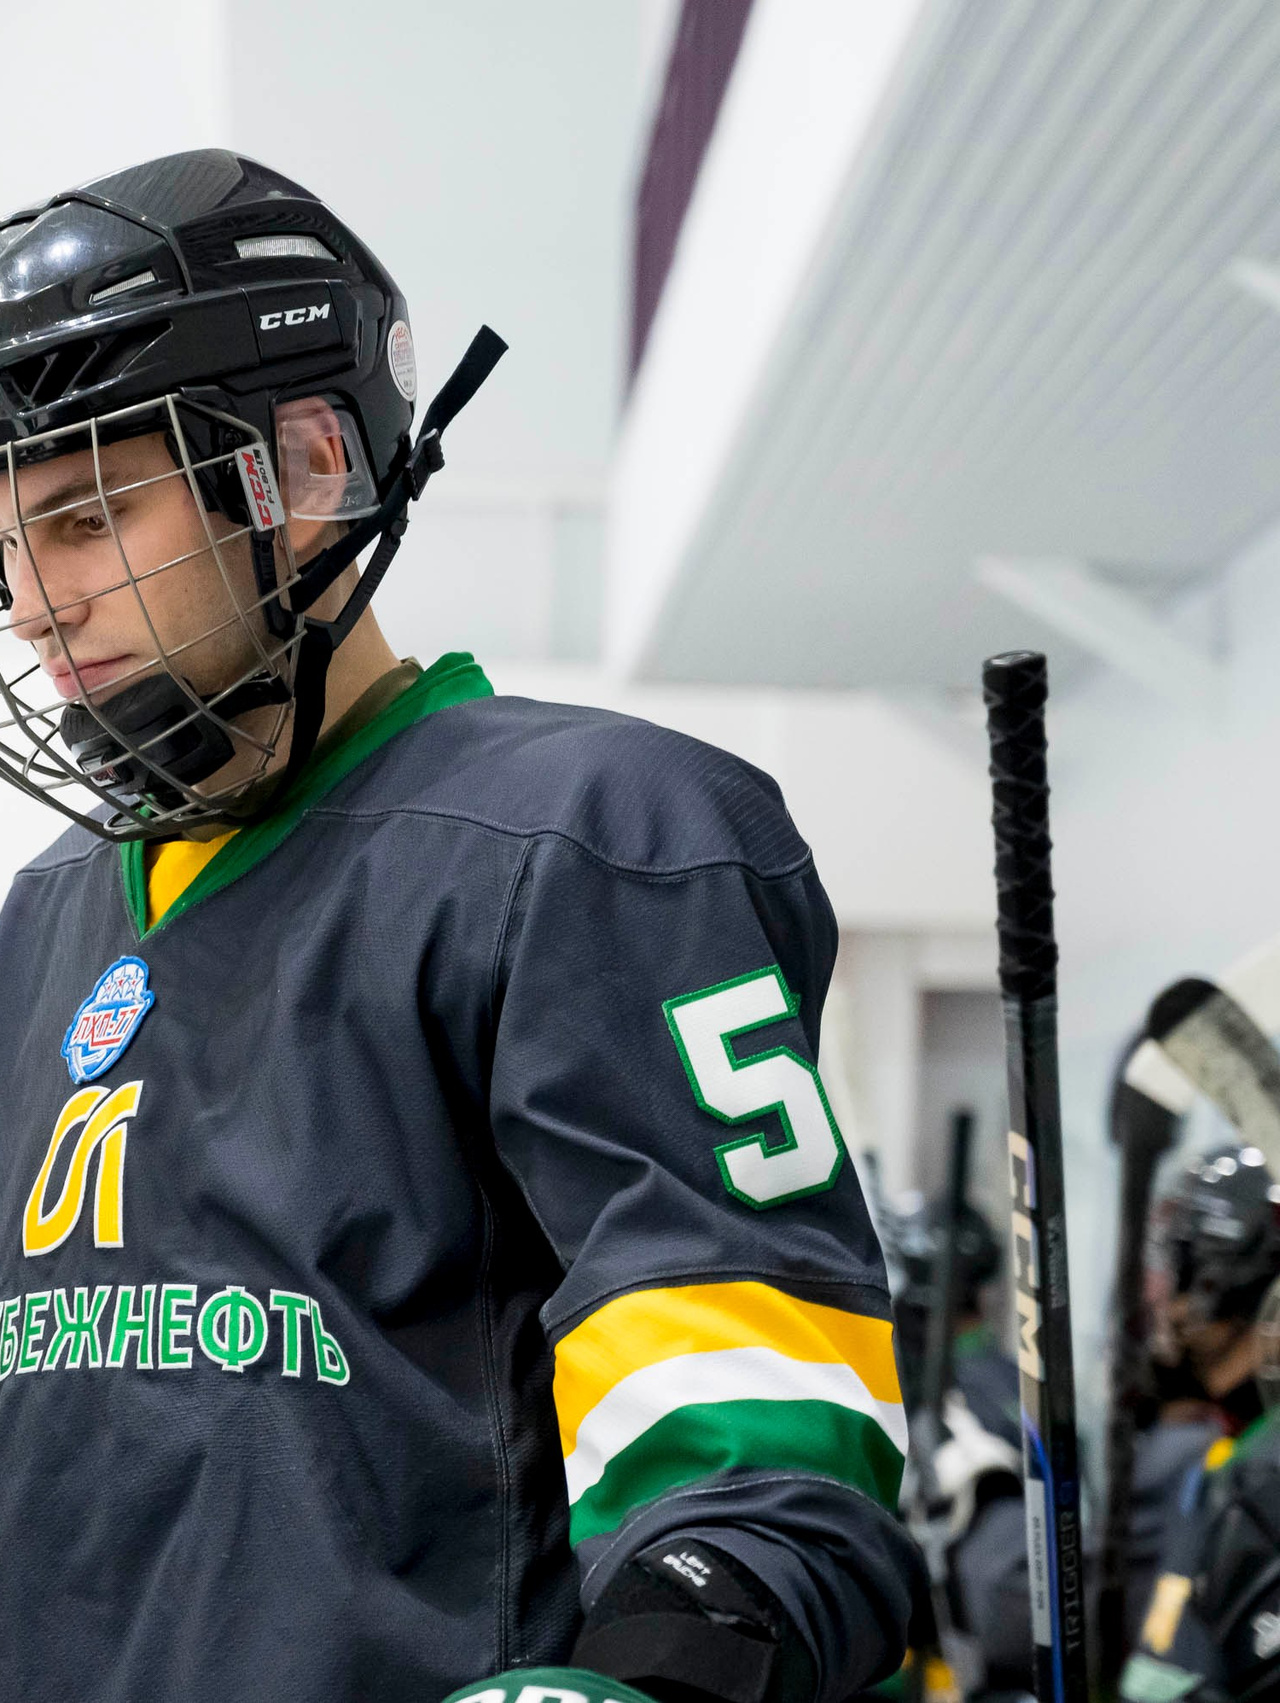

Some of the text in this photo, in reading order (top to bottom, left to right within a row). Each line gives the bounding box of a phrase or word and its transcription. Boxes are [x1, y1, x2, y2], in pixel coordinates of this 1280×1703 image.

[259, 303, 331, 331] CCM
[241, 452, 274, 528] CCM
[661, 963, 846, 1212] 5
[1007, 1130, 1047, 1383] CCM
[1060, 1510, 1081, 1652] TRIGGER
